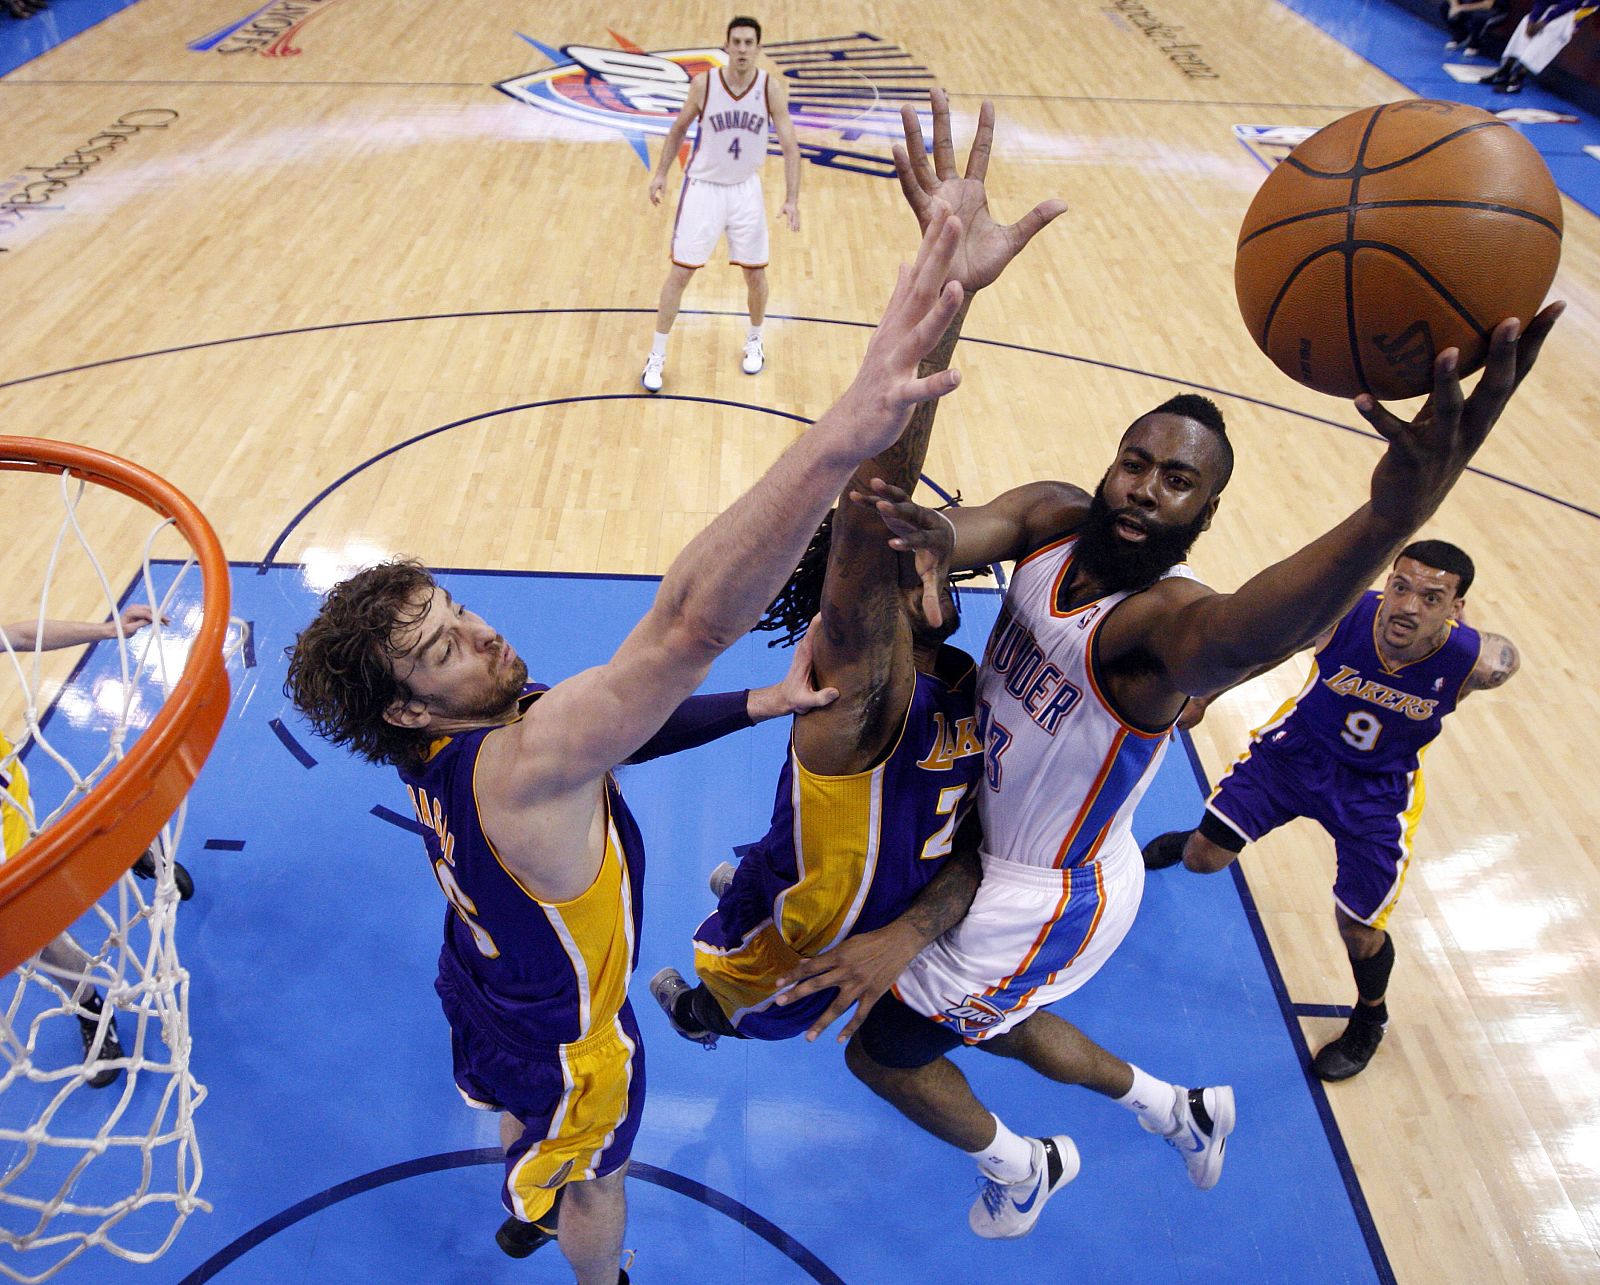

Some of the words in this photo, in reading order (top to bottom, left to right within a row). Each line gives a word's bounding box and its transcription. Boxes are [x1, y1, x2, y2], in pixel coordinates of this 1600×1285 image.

[709, 110, 765, 135] THUNDER
[727, 137, 742, 160] 4
[1322, 664, 1440, 721] LAKERS
[1340, 710, 1384, 751] 9
